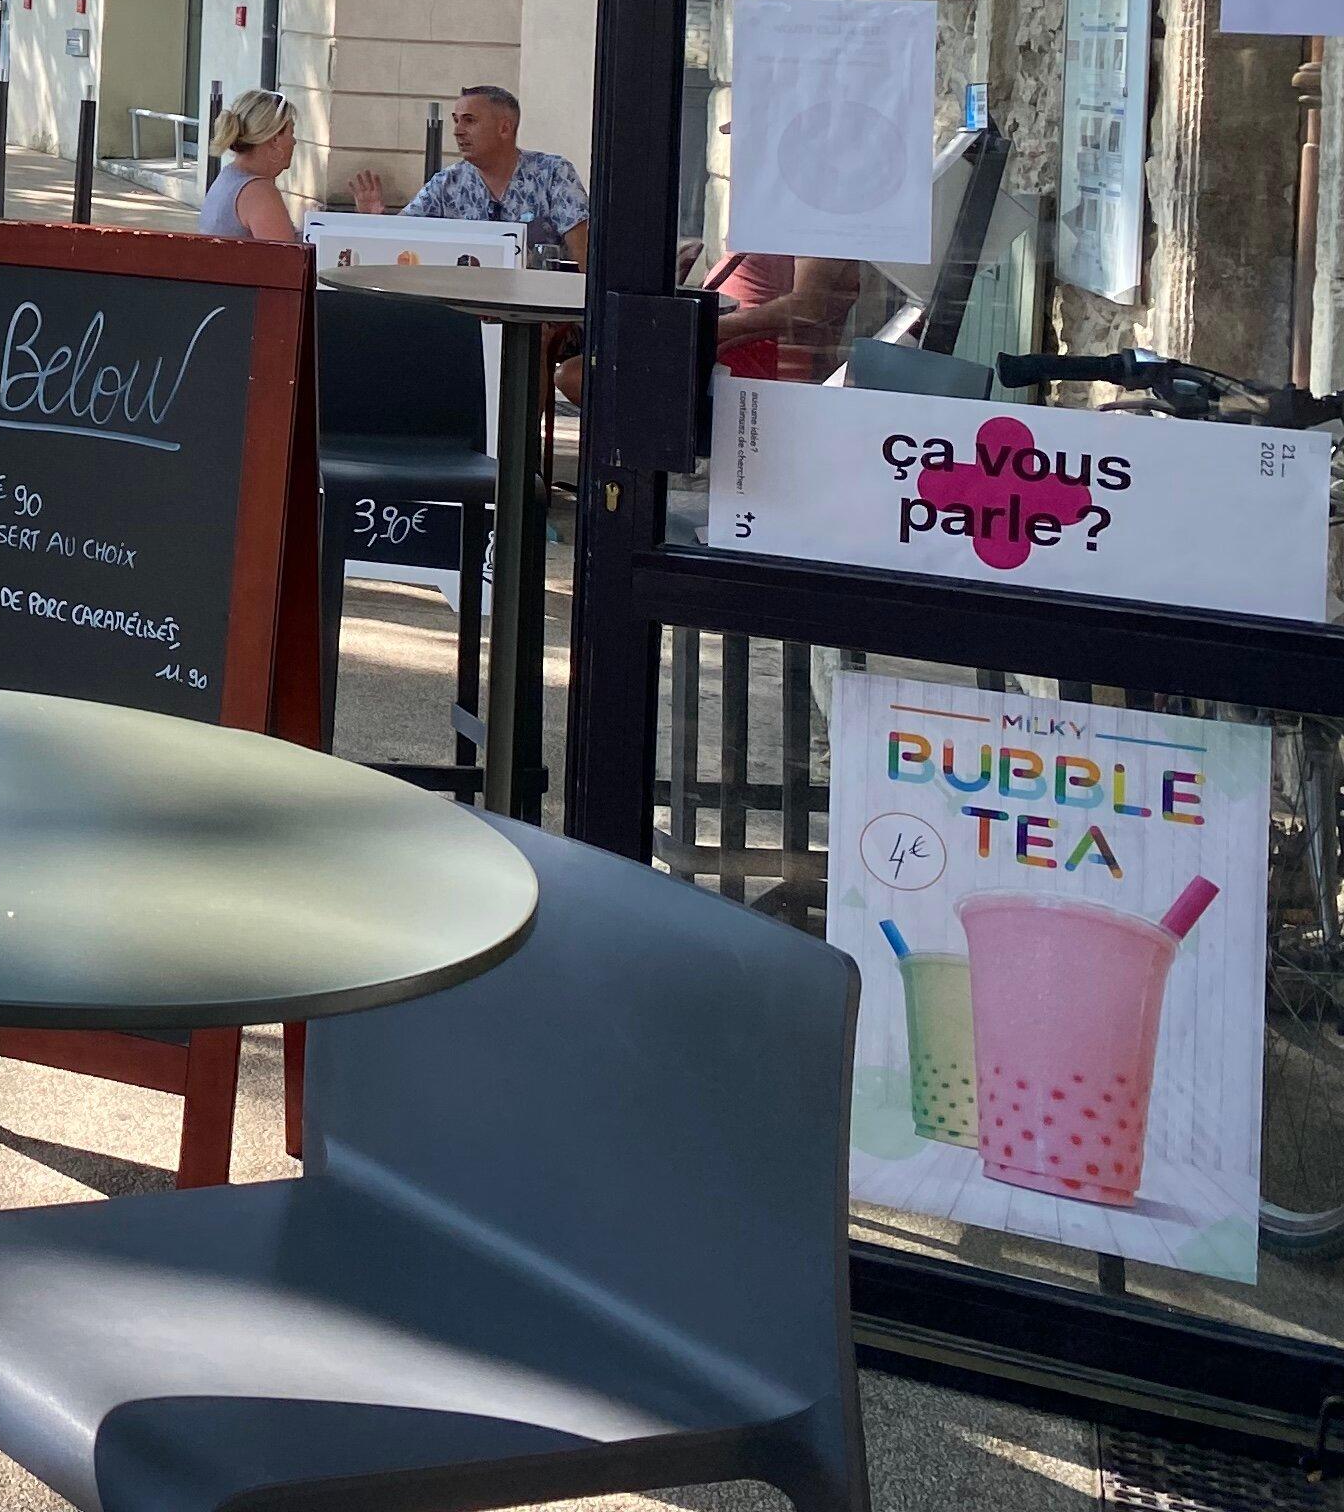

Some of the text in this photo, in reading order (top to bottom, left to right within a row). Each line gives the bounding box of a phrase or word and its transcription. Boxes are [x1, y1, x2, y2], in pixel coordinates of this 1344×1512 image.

[0, 300, 227, 425] Below
[738, 390, 747, 435] continuez
[881, 432, 1132, 491] ça vous
[1258, 441, 1275, 478] 2022
[46, 532, 76, 557] AU
[353, 498, 430, 548] 3,90€
[899, 493, 1062, 547] parle
[0, 587, 23, 612] DE
[28, 592, 68, 622] PORC
[1001, 714, 1087, 739] MILKY
[888, 731, 1206, 826] BUBBLE
[888, 832, 931, 880] 4€
[961, 805, 1124, 879] TEA
